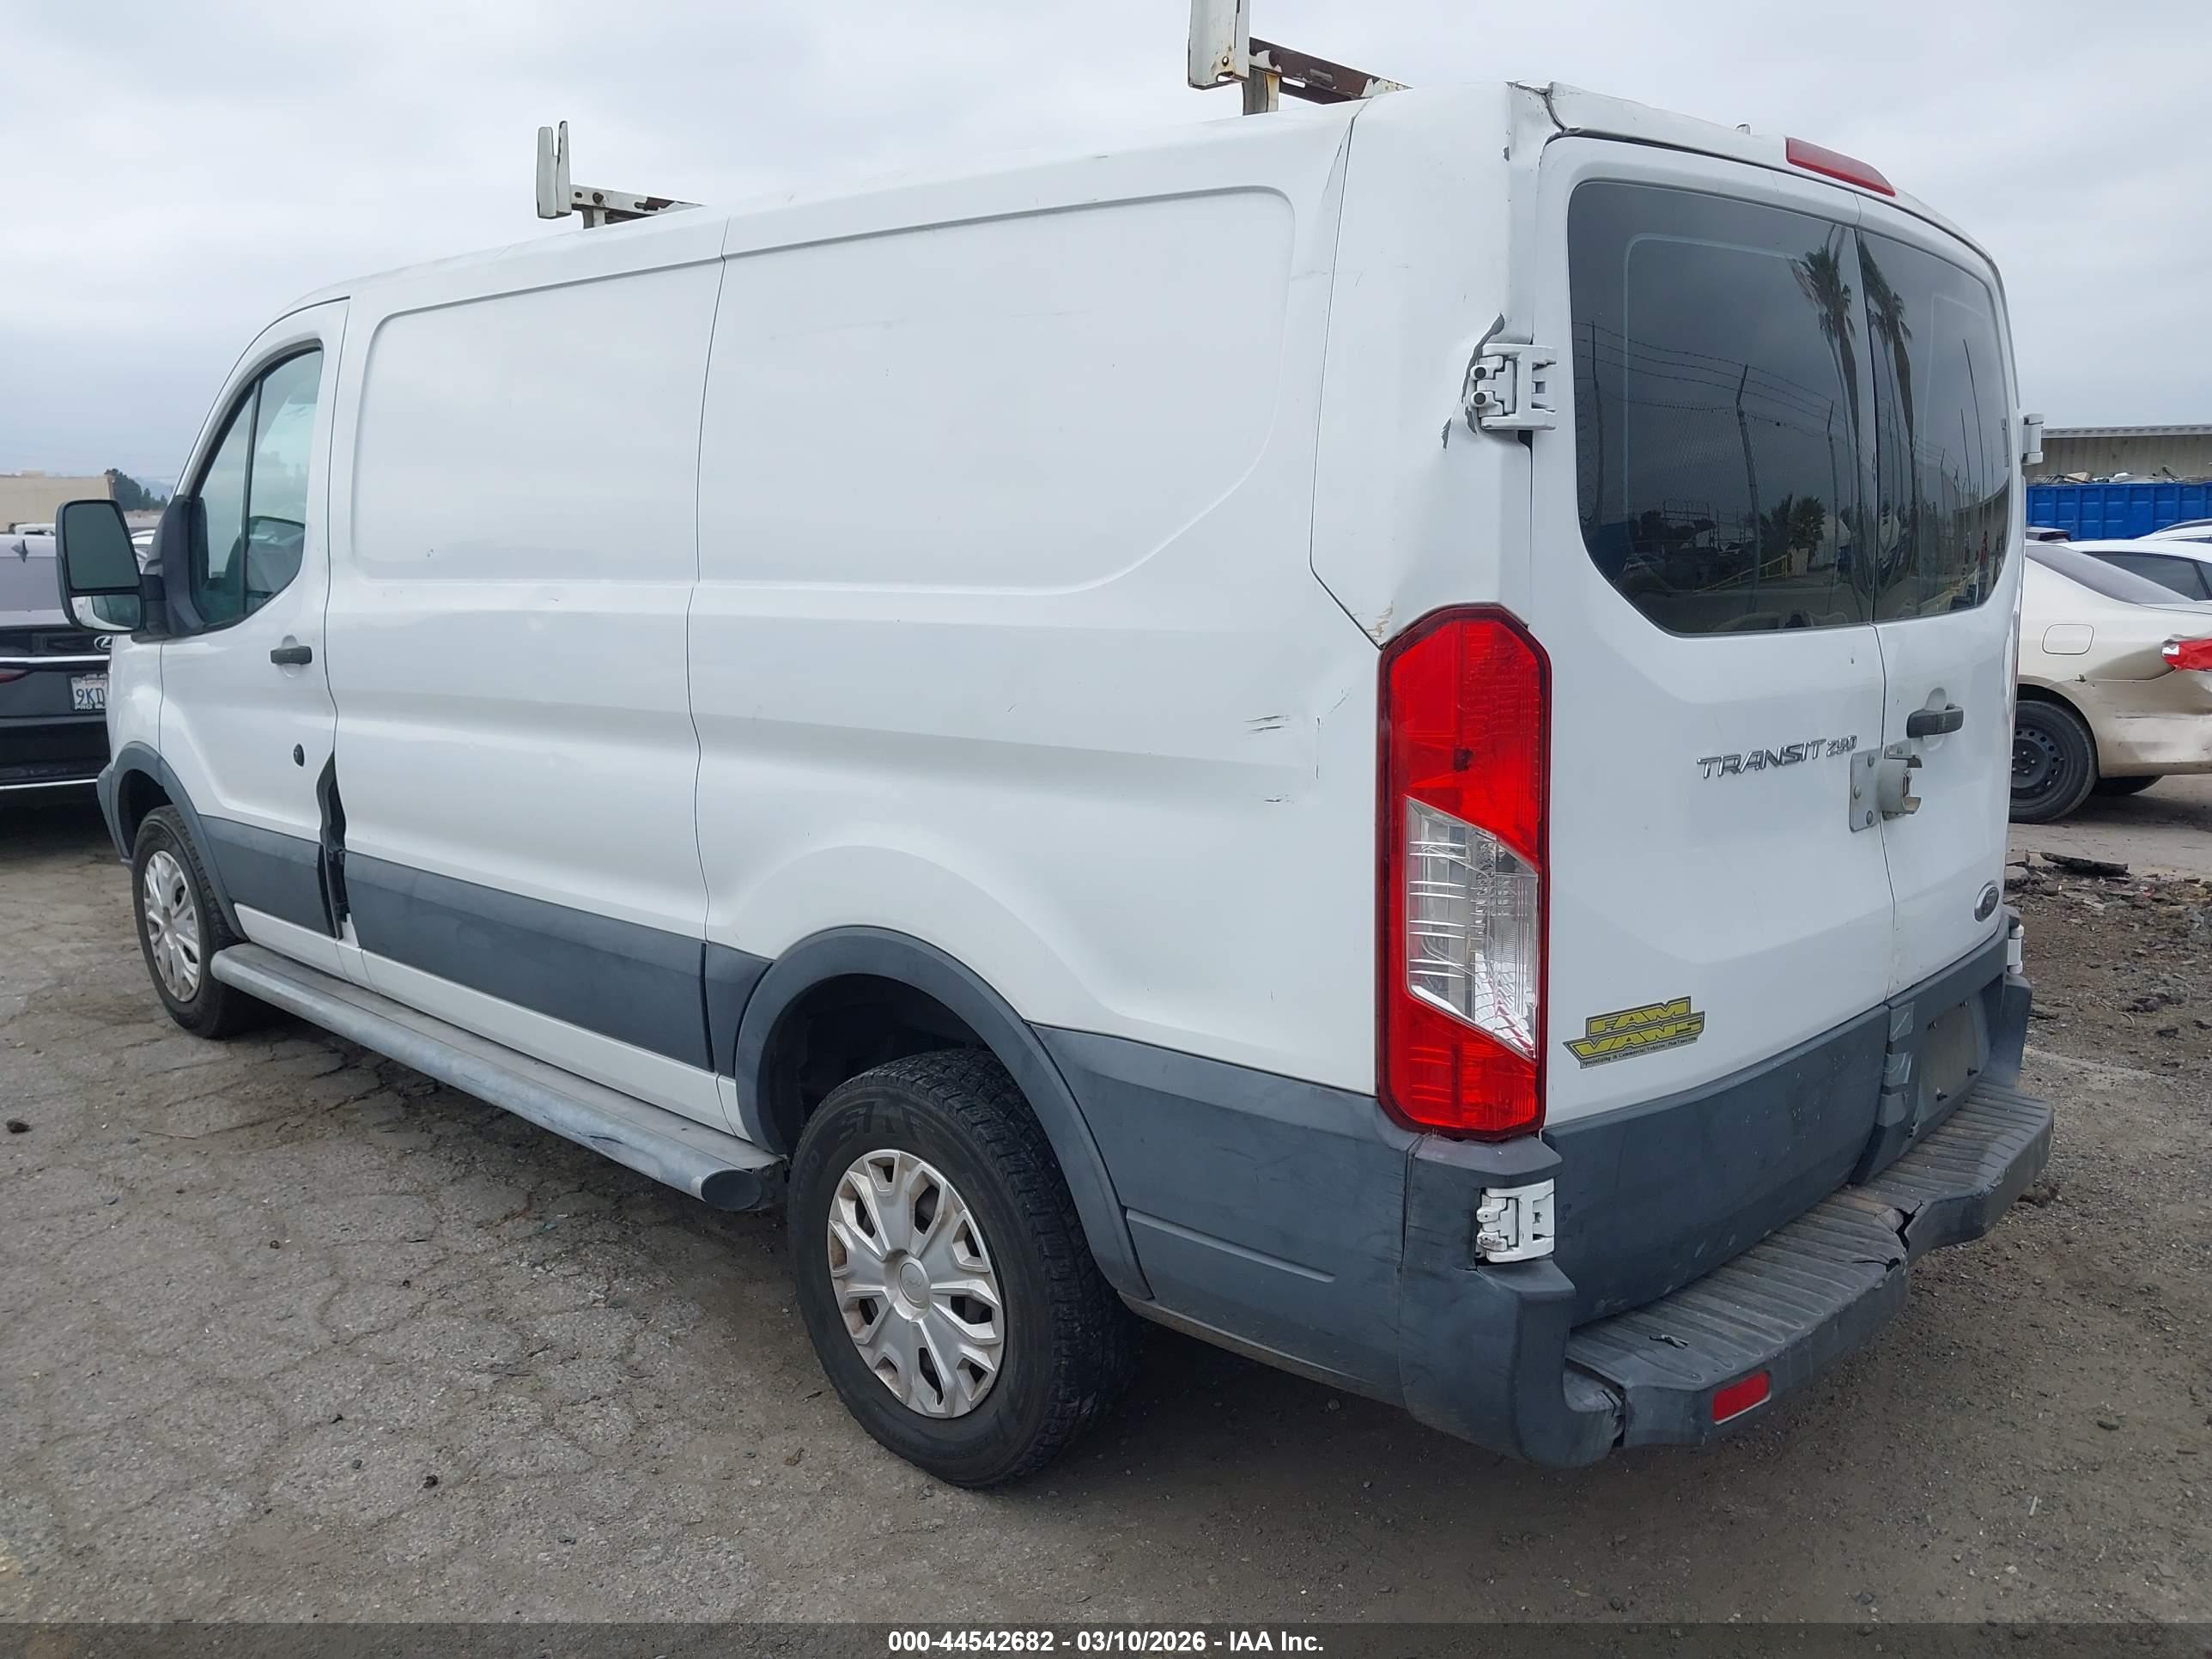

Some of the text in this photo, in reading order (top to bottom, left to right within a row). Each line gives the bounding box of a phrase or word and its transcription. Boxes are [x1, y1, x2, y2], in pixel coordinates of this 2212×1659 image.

[1697, 734, 1857, 779] TRANSIT 250
[1589, 1000, 1688, 1035] FAM
[1573, 1018, 1704, 1056] VANS
